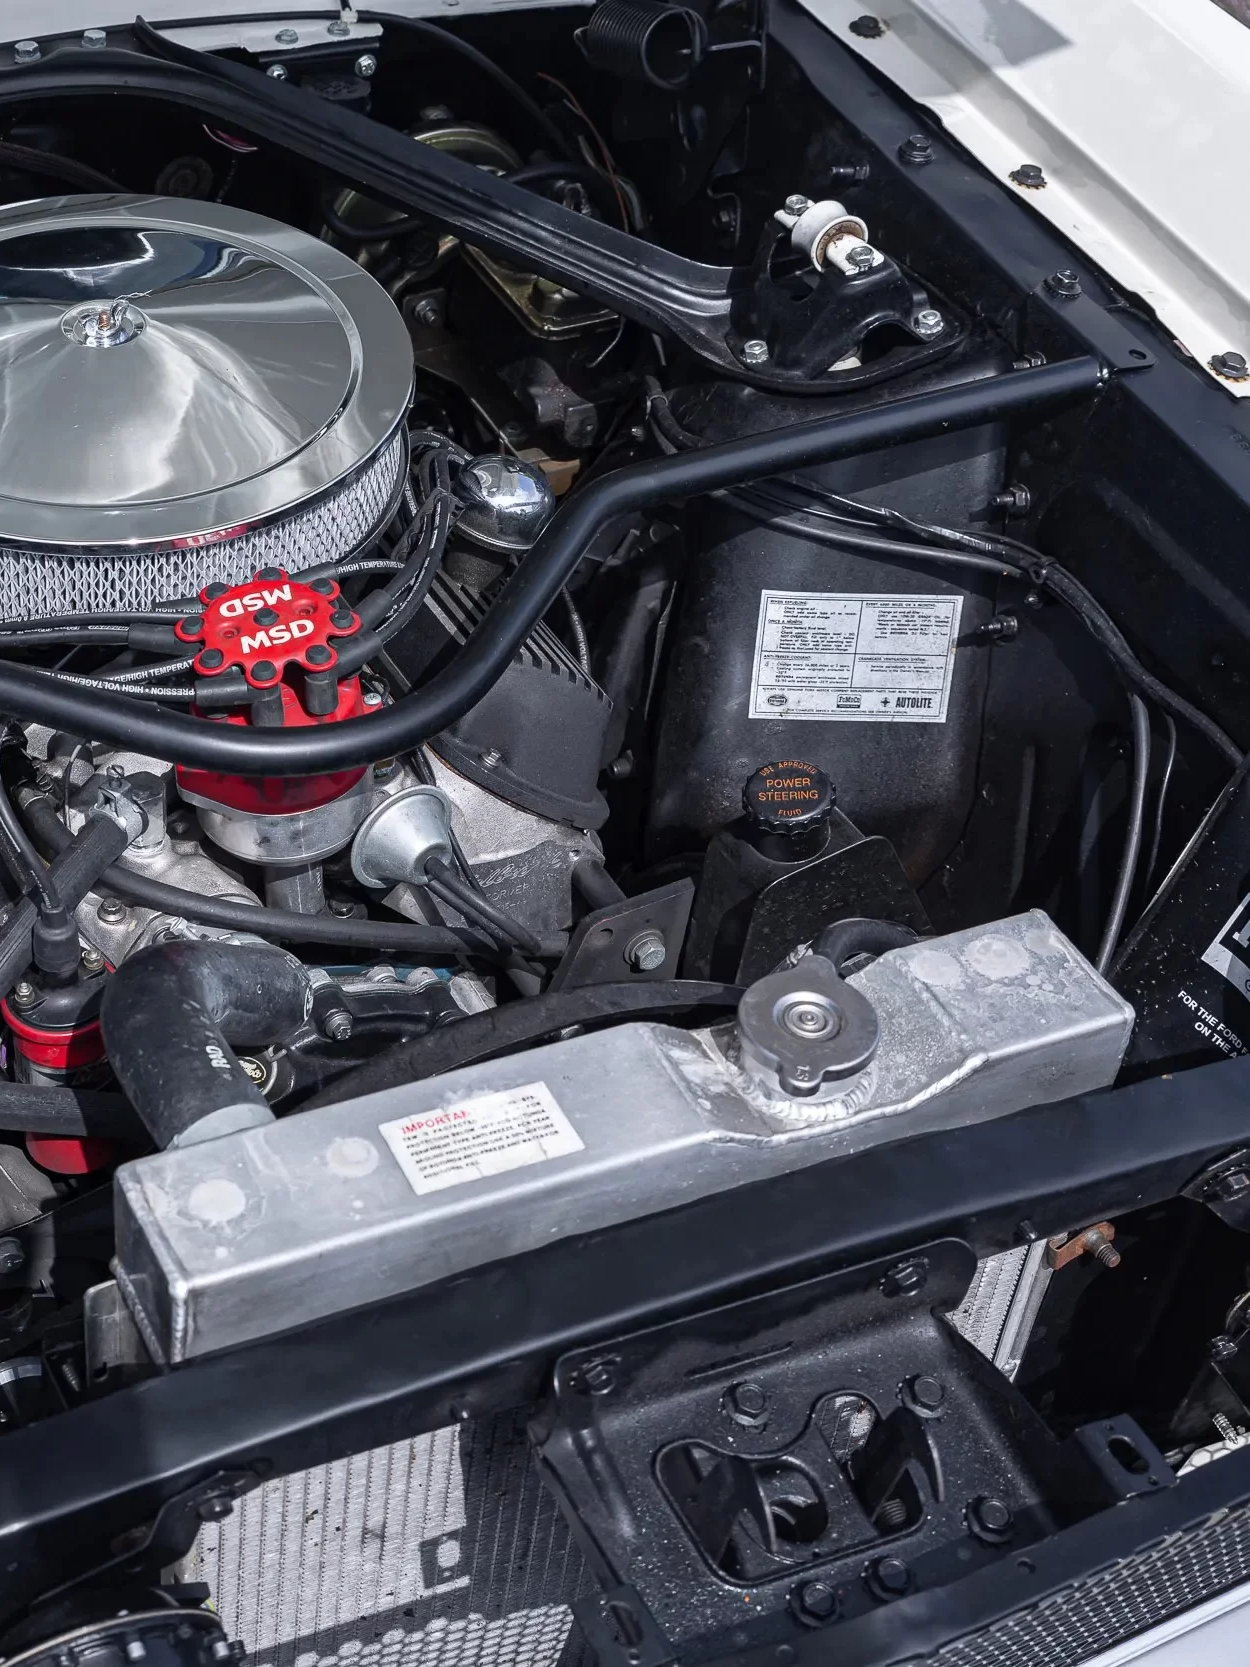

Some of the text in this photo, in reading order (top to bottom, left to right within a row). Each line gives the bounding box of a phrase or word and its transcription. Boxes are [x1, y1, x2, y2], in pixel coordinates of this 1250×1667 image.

[219, 584, 292, 617] MSD
[30, 608, 90, 620] TEMPERATURE
[240, 619, 314, 654] MSD
[122, 683, 143, 694] HIGH
[896, 697, 932, 708] AUTOLITE
[759, 761, 818, 776] USE APPROVED
[766, 778, 811, 788] POWER
[758, 790, 818, 801] STEERING
[778, 808, 802, 816] FLUID
[1177, 990, 1242, 1049] FOR THE FORD
[1194, 1021, 1212, 1037] ON
[1211, 1033, 1231, 1054] THE
